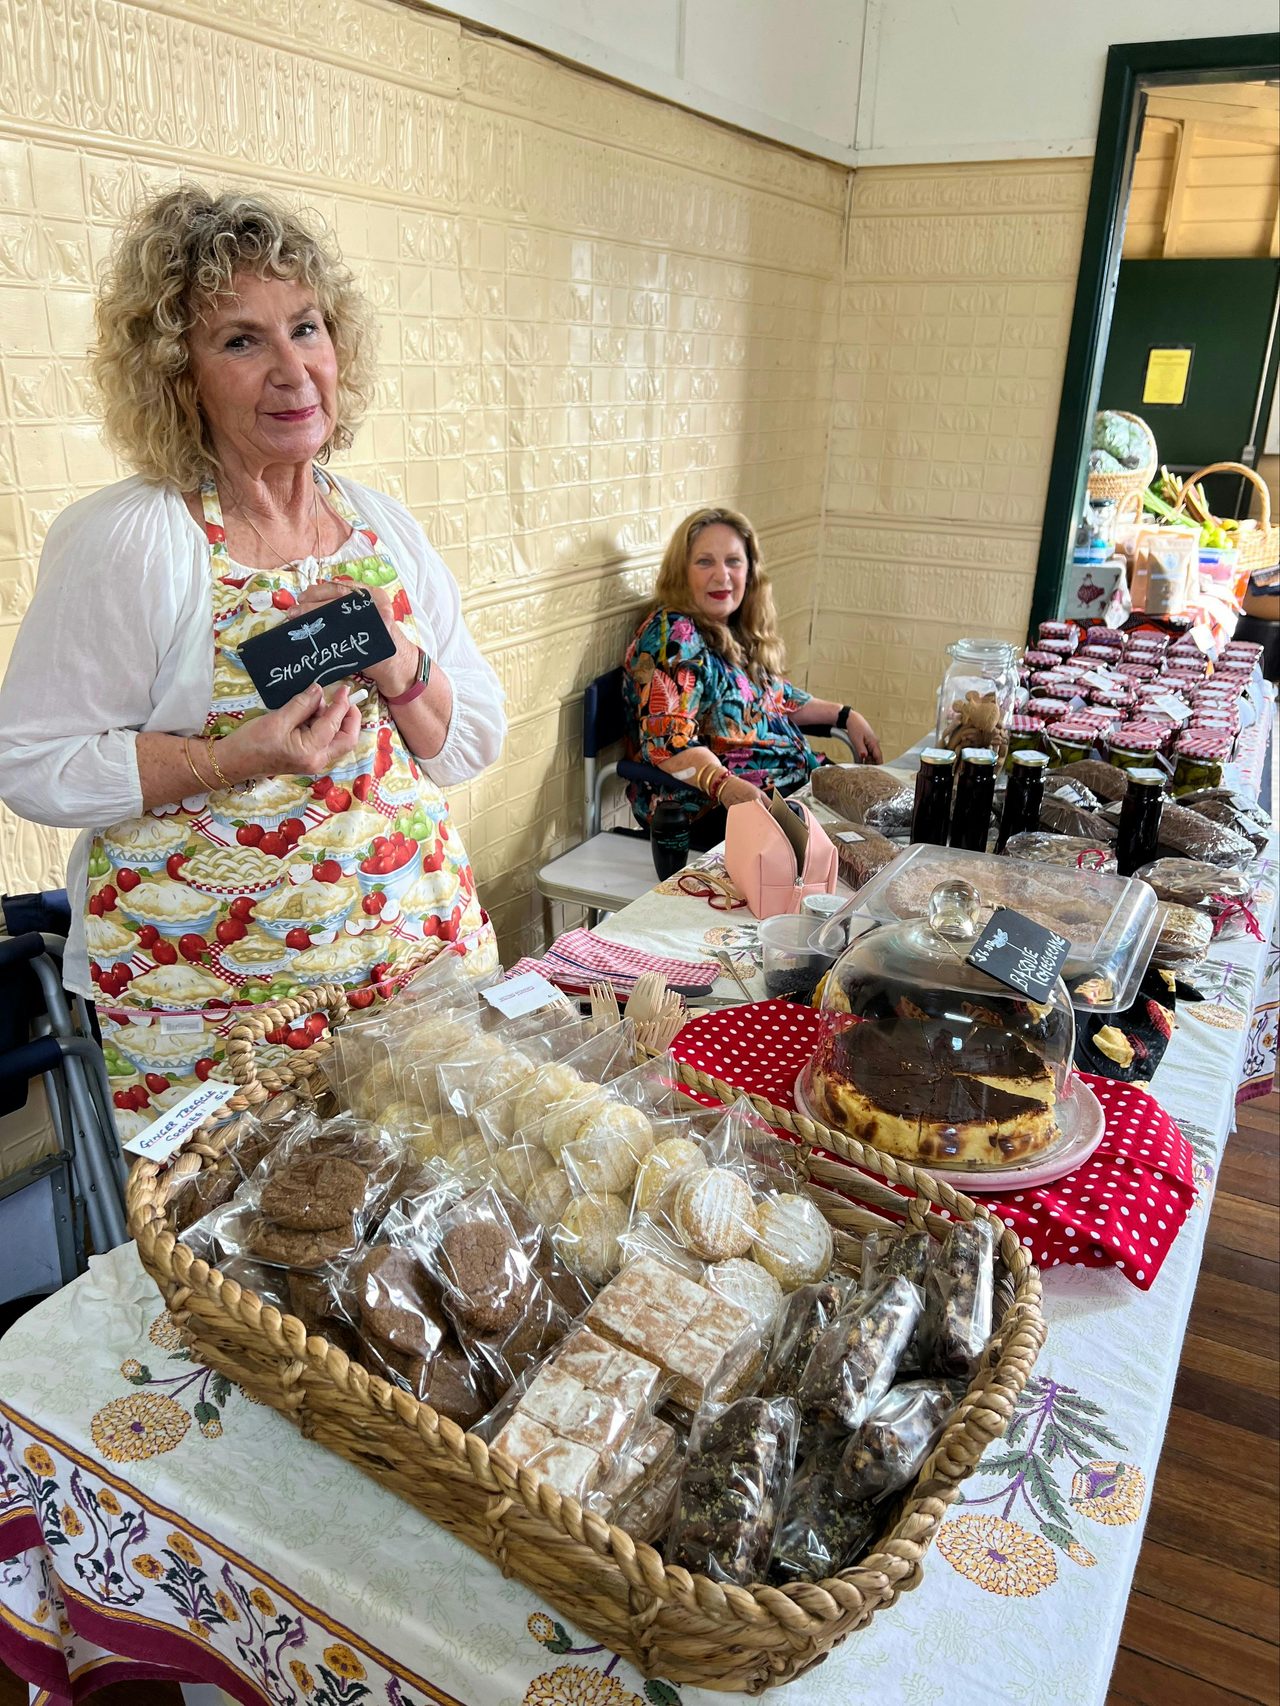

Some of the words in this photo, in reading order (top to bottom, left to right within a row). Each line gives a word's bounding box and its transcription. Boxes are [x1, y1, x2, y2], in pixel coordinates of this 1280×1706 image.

[265, 632, 369, 688] SHORTBREAD
[1009, 947, 1040, 992] BASQUE
[1035, 931, 1066, 982] CHEESECAKE
[140, 1121, 177, 1149] GINGER
